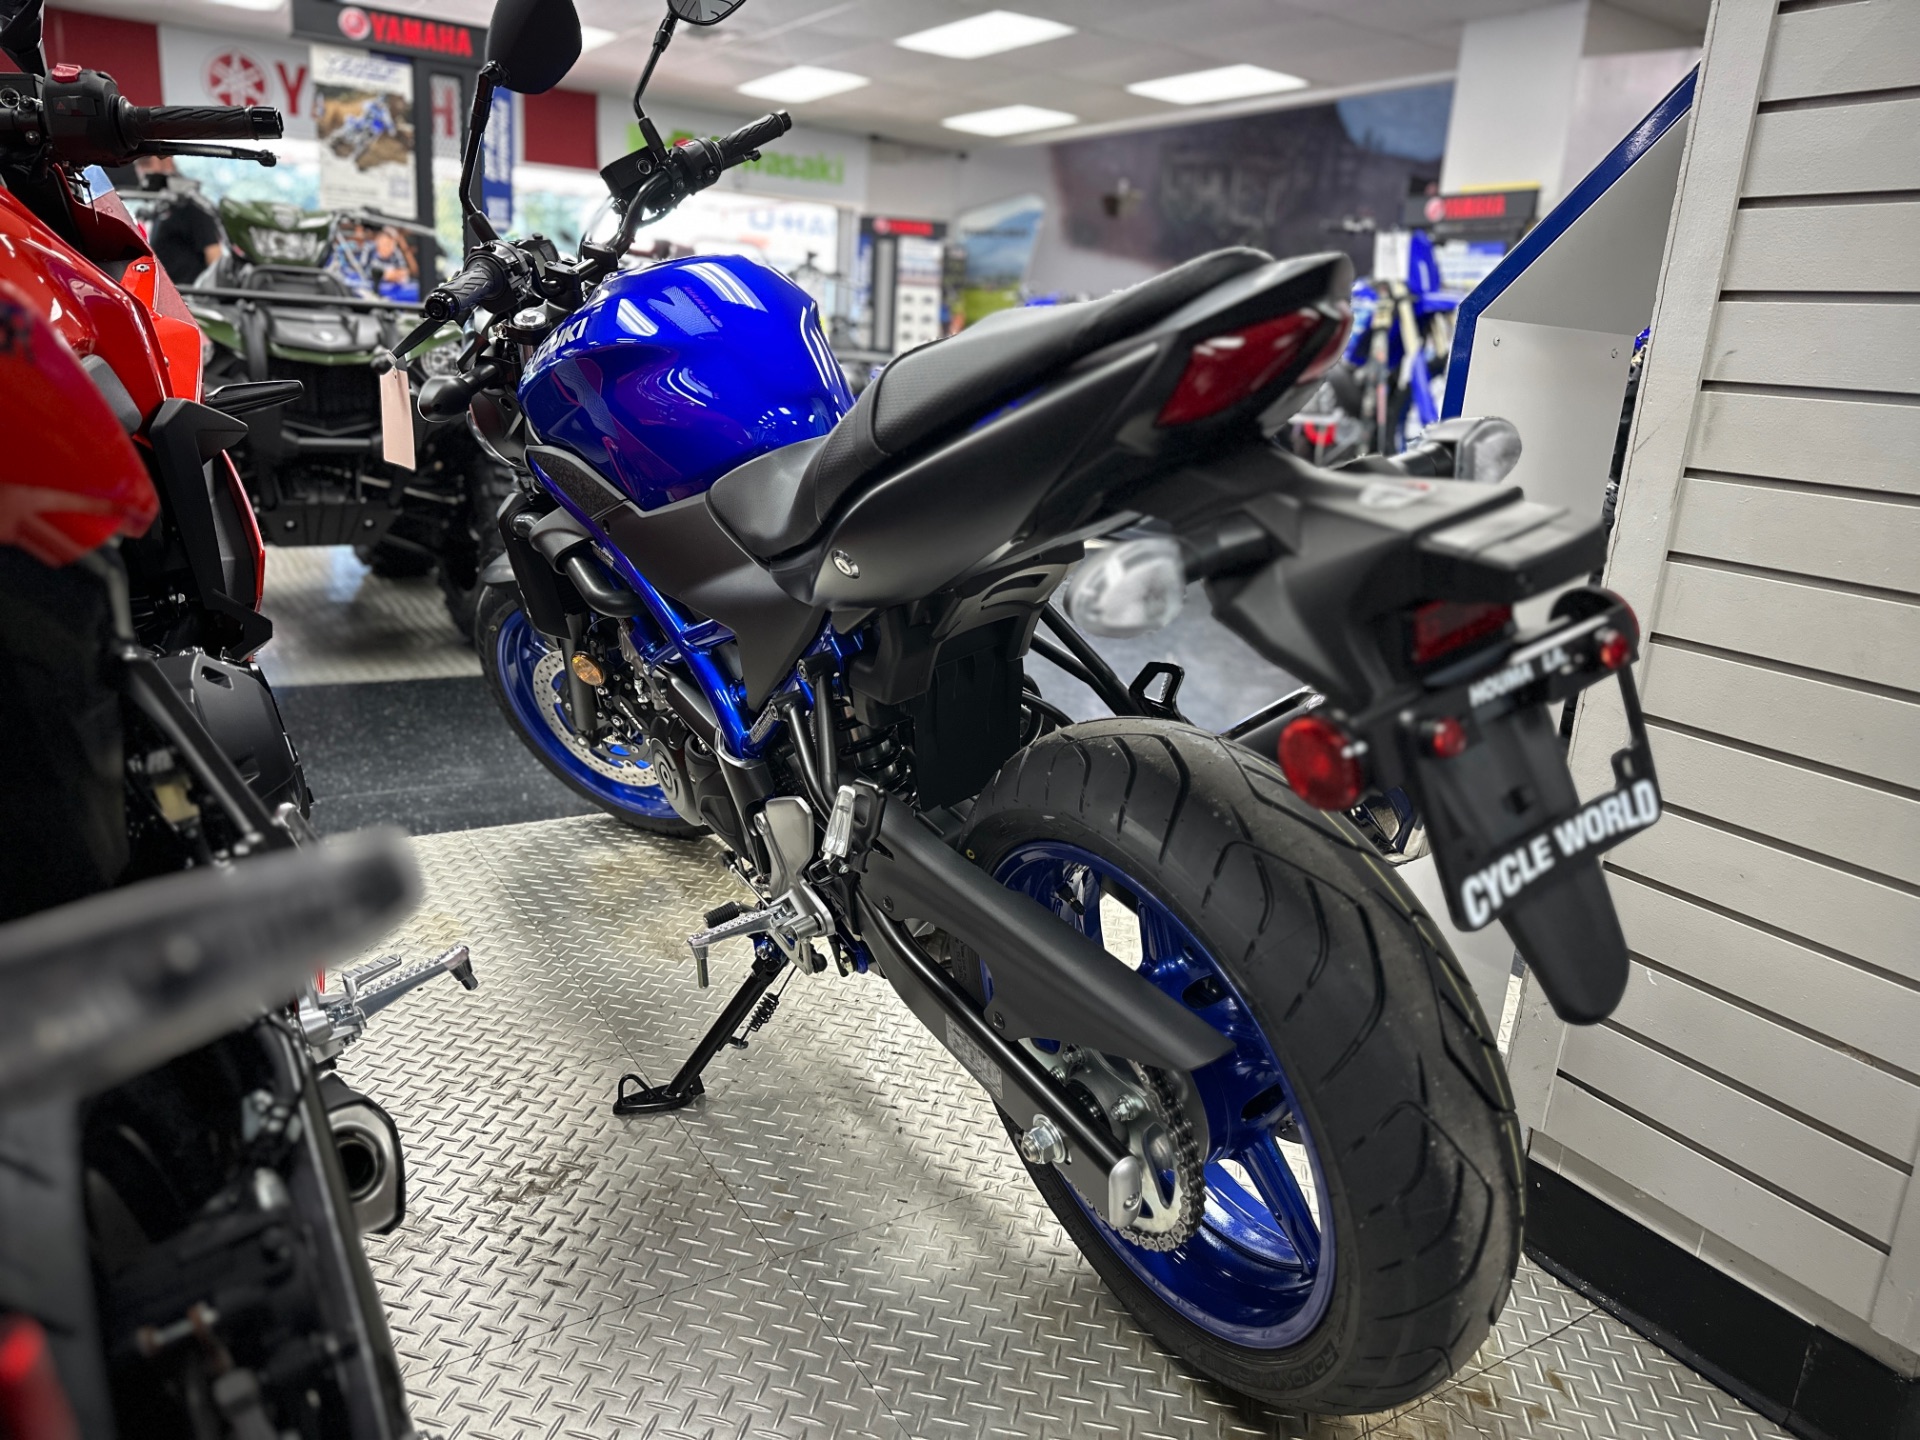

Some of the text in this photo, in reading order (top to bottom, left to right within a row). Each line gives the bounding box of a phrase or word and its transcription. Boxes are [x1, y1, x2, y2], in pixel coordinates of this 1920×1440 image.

[368, 12, 473, 57] YAMAHA
[1461, 778, 1659, 928] CYCLE WORLD
